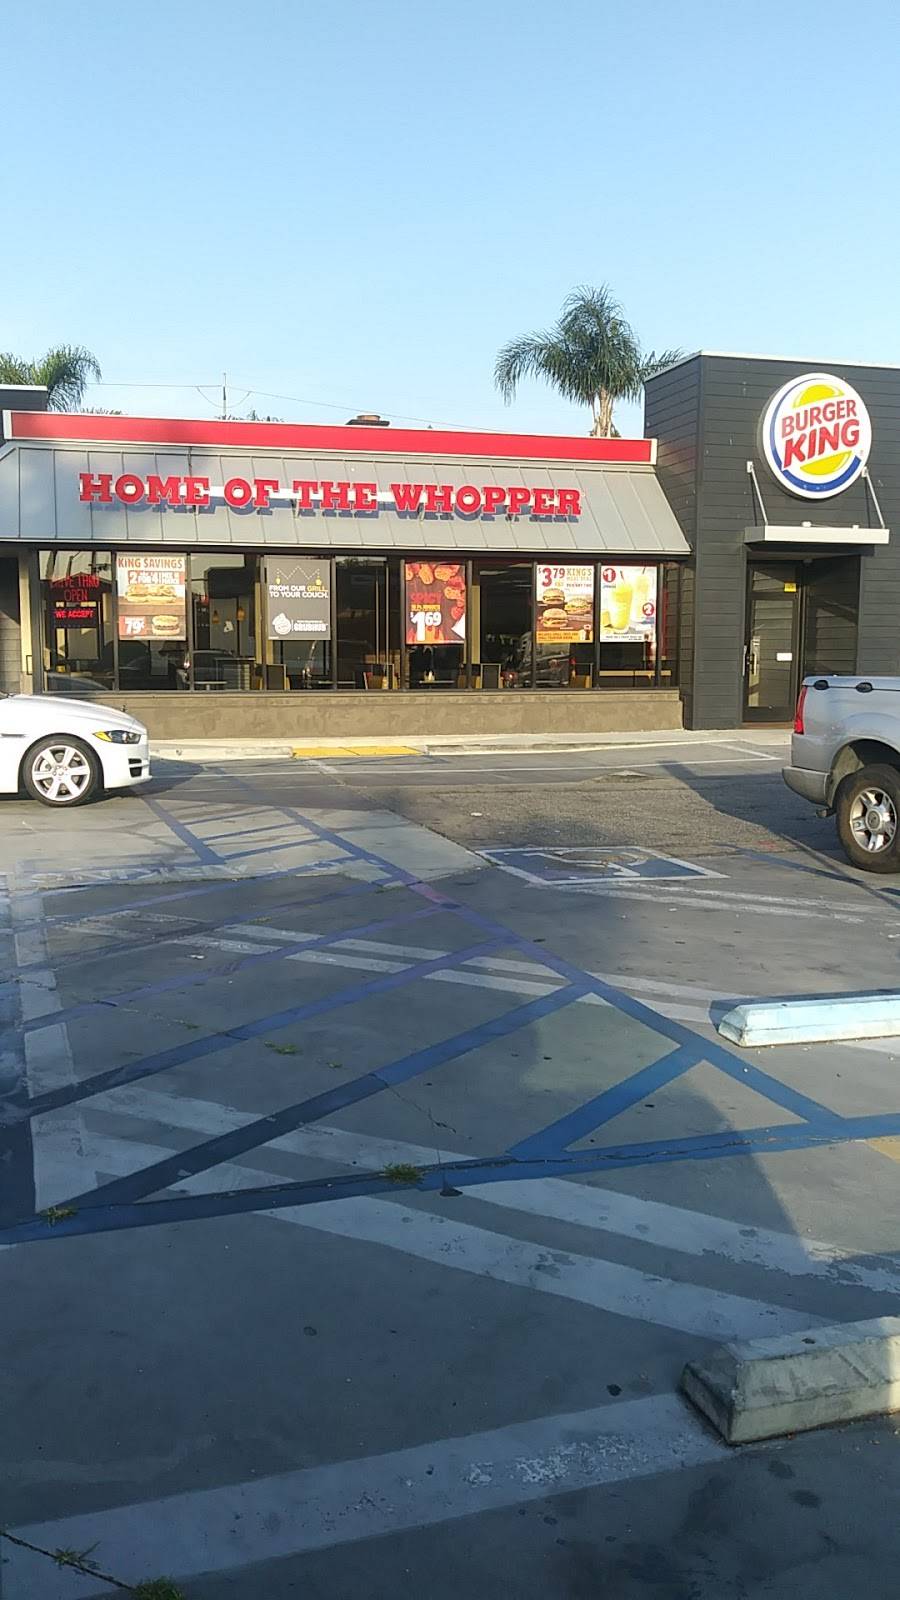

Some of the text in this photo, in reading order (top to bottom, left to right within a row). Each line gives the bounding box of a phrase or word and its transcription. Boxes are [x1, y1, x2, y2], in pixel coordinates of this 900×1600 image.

[782, 399, 857, 438] BURGER
[784, 419, 860, 468] KING
[79, 472, 582, 516] HOME OF THE WHOPPER
[118, 558, 183, 569] KING SAVINGS
[64, 588, 88, 602] OPEN
[268, 584, 290, 592] FROM
[55, 609, 94, 618] WE ACCEPT
